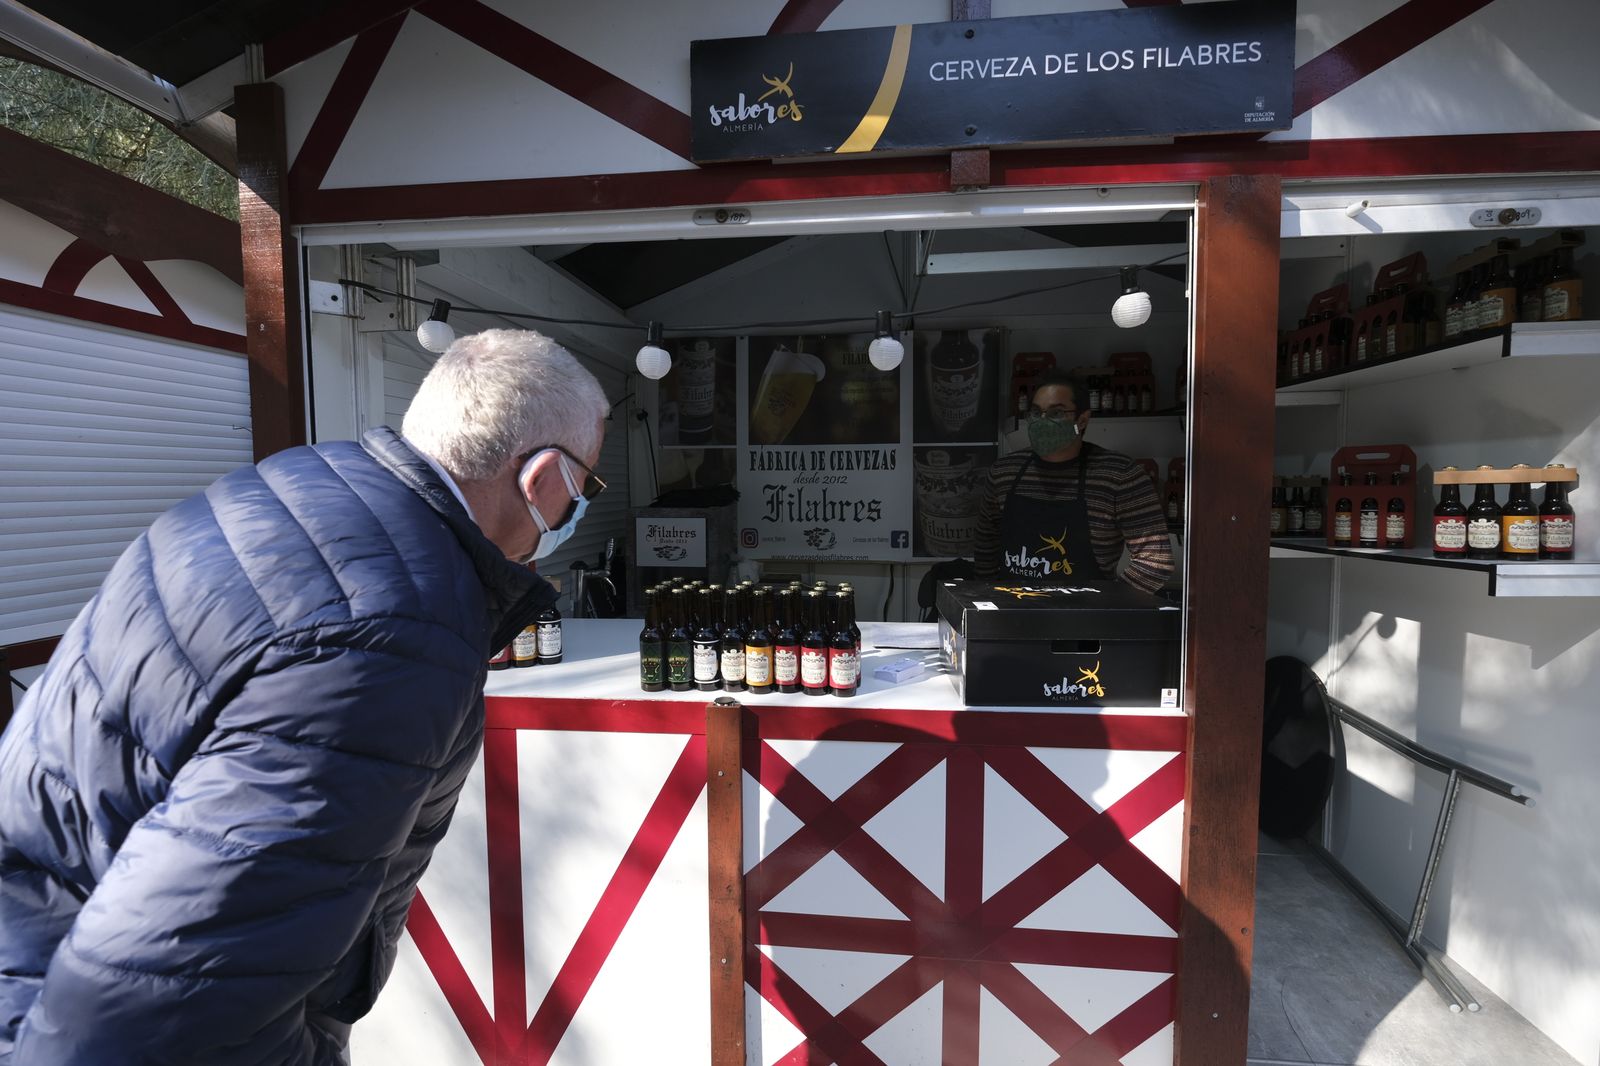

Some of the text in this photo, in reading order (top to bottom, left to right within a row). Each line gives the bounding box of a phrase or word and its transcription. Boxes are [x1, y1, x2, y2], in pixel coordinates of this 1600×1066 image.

[930, 41, 1262, 81] CERVEZA DE LOS FILABRES
[709, 93, 805, 126] sabores
[722, 123, 764, 134] ALMERÍA
[750, 444, 897, 471] FÁBRICA DE CERVEZAS
[793, 472, 848, 484] desde 2012
[761, 484, 882, 523] Filabres
[646, 525, 697, 541] Filabres
[1004, 546, 1075, 575] sabores
[1009, 566, 1043, 579] ALMERÍA
[1043, 677, 1106, 698] sabores
